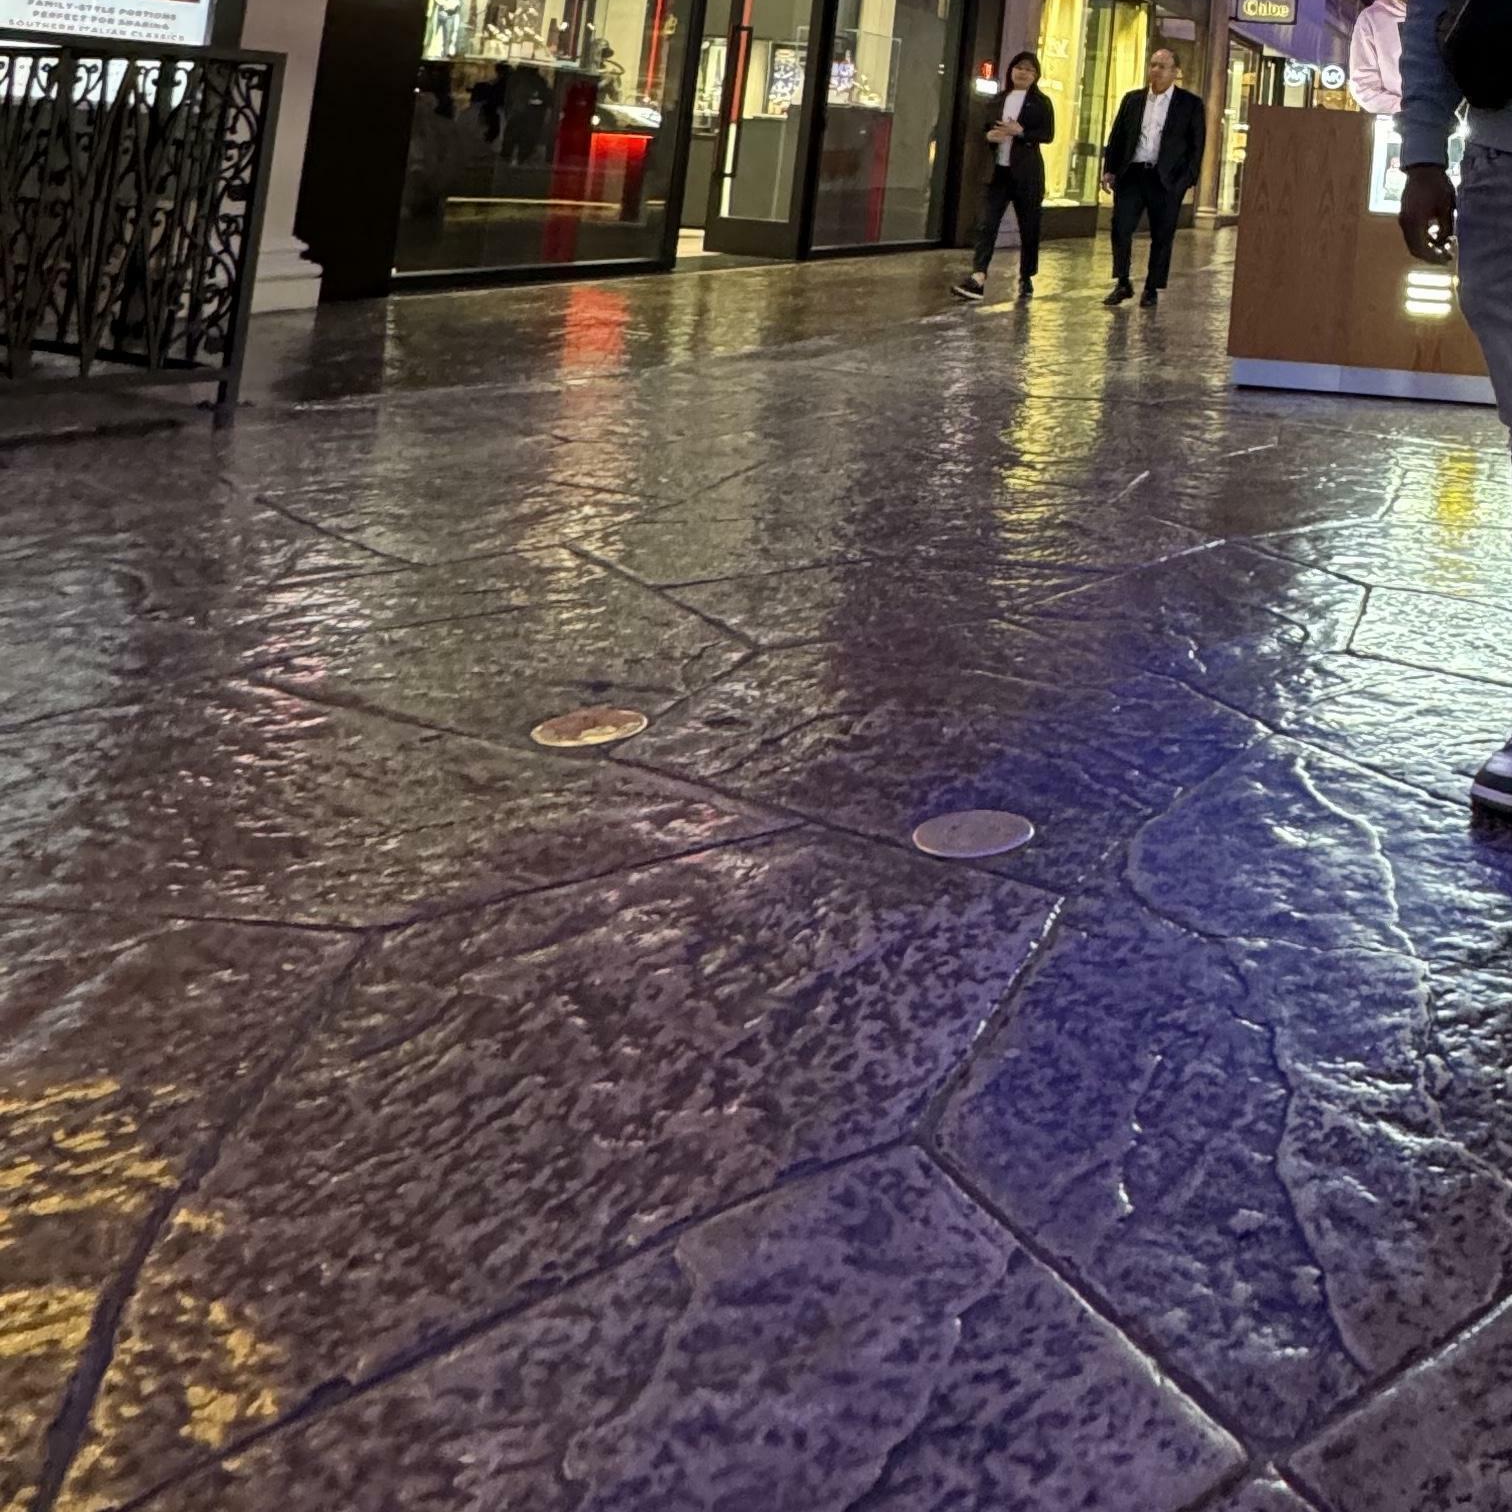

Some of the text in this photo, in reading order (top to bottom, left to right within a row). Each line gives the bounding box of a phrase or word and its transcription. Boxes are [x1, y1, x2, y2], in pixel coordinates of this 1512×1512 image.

[33, 10, 169, 30] PERFECT FOR SHARING
[119, 8, 176, 21] PORTIONS
[9, 19, 75, 30] SOUTHERN
[131, 30, 185, 41] CLASSICS
